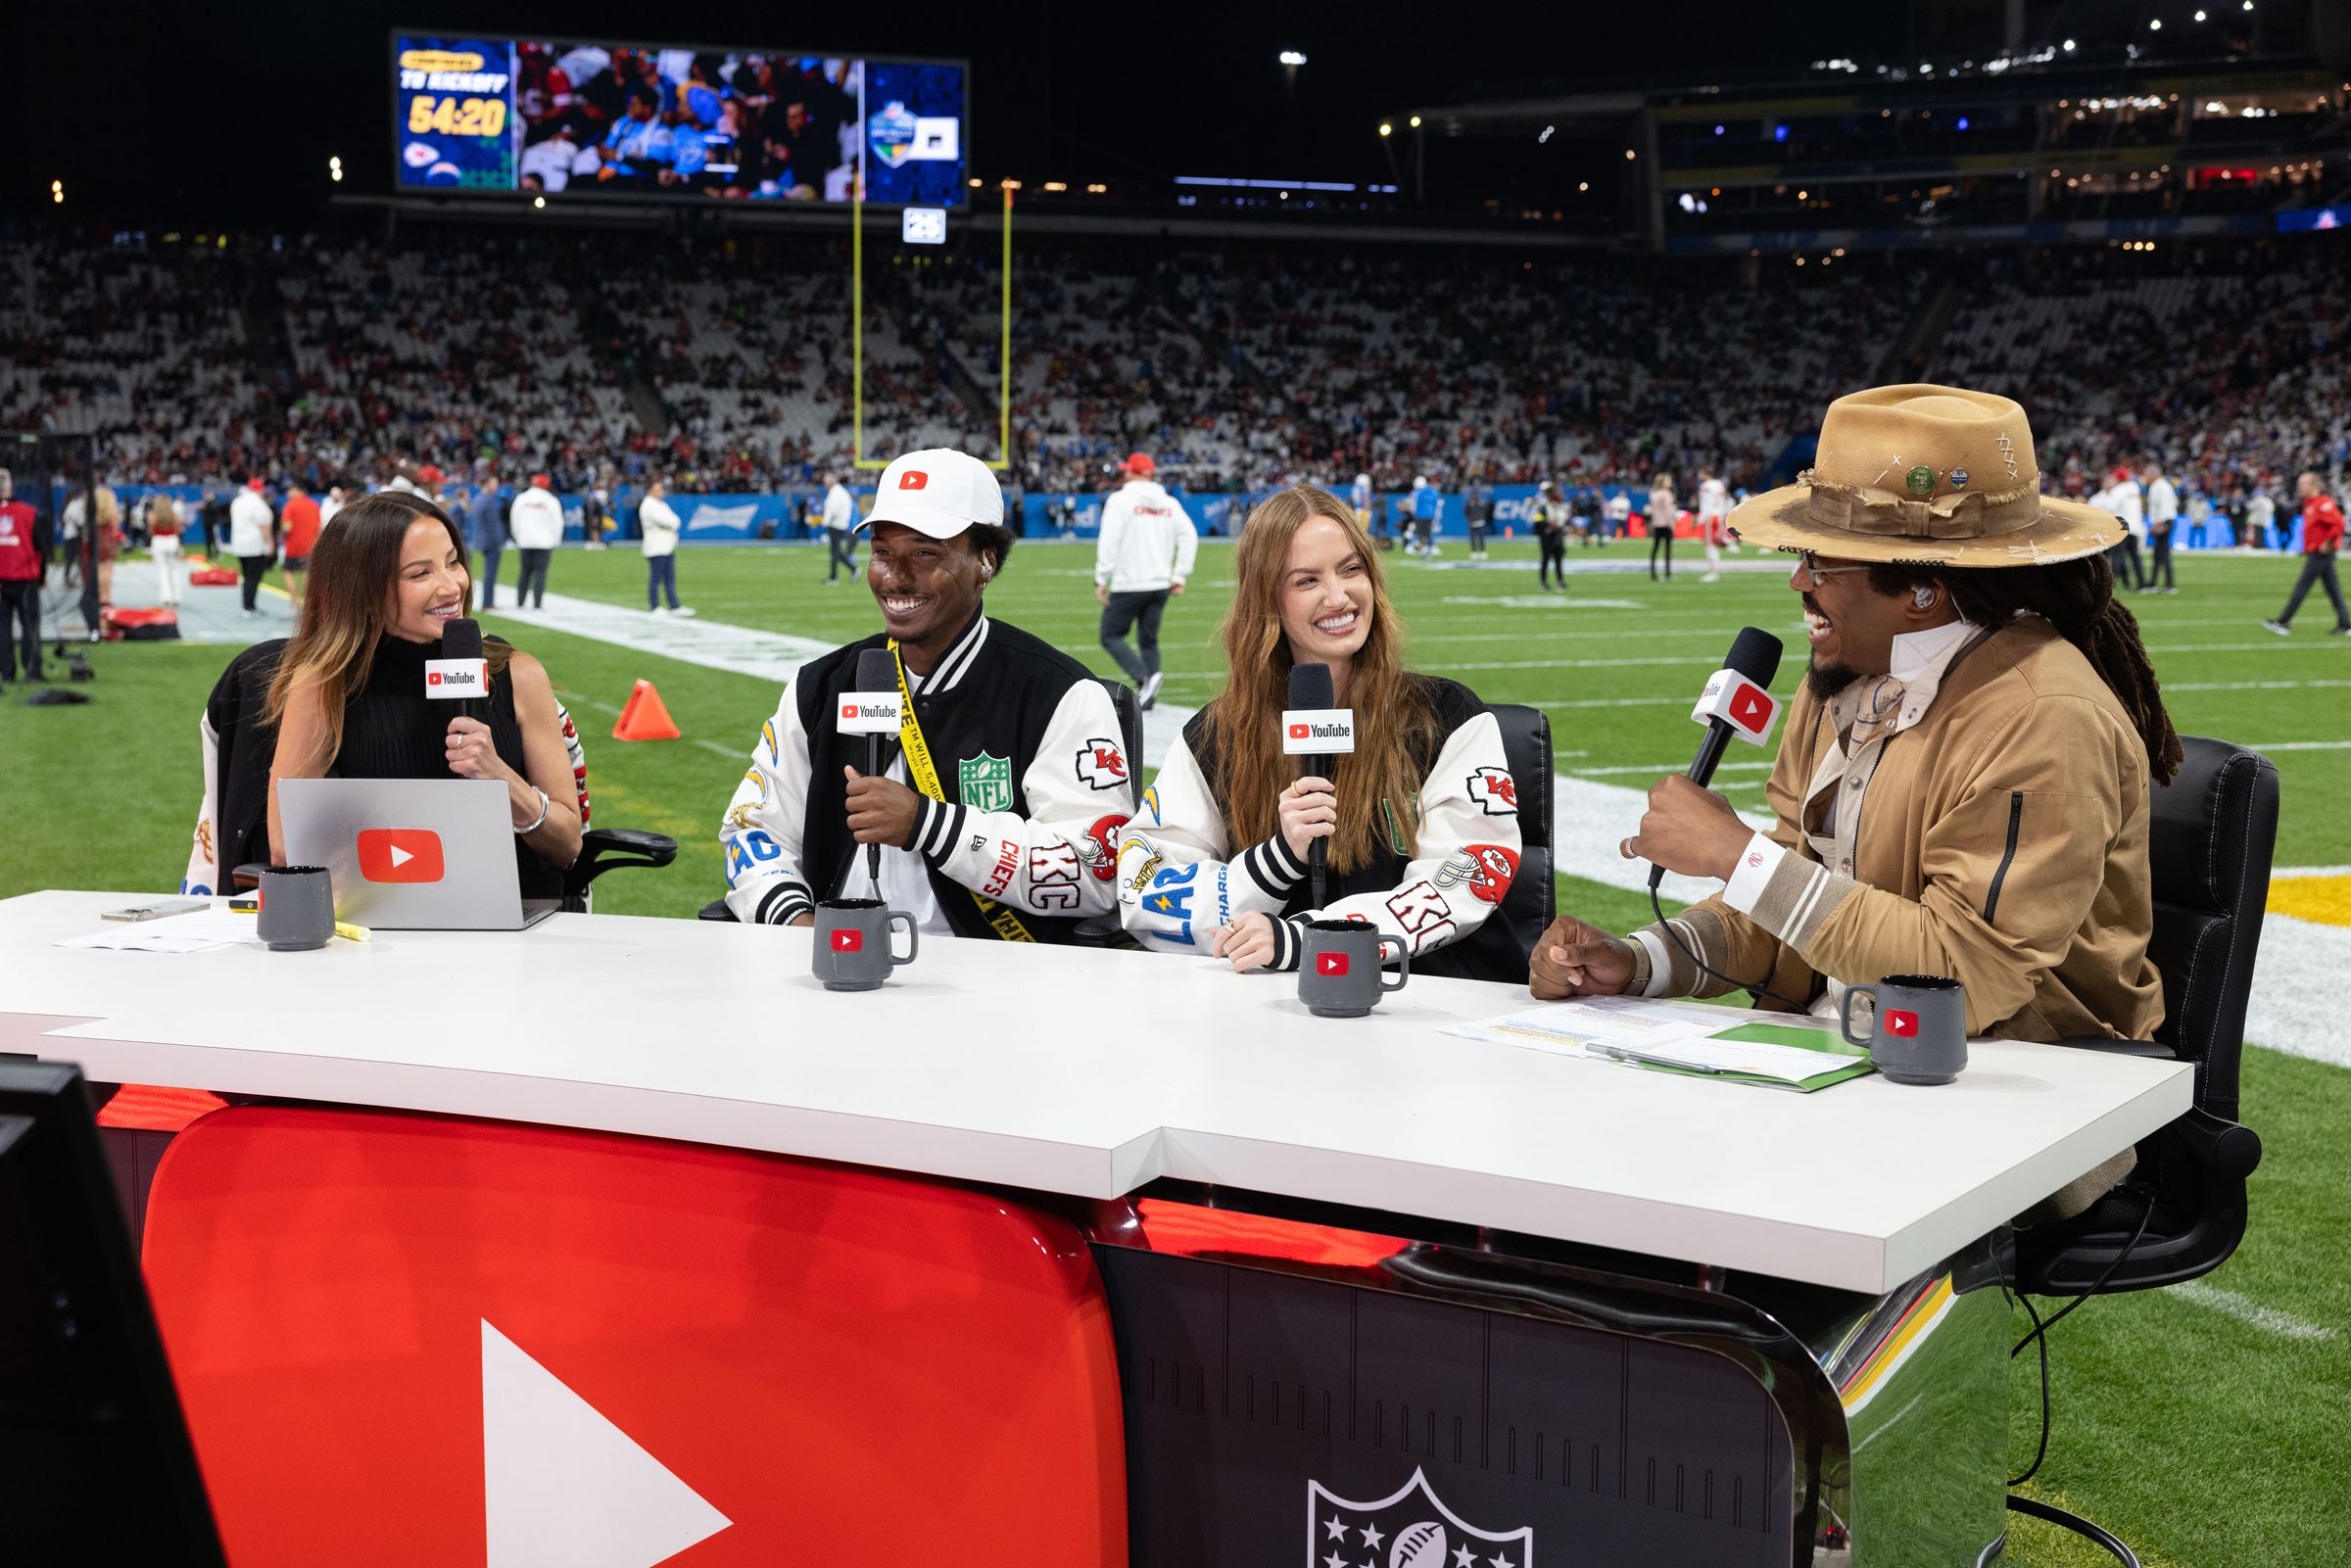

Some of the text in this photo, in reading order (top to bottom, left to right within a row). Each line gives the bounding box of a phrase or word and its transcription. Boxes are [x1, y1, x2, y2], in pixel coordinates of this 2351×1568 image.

[408, 95, 505, 136] 54:20
[443, 672, 475, 685] YouTube
[860, 705, 896, 717] YouTube
[1311, 724, 1350, 737] YouTube
[1093, 748, 1127, 778] KC
[966, 781, 1008, 809] NFL
[1485, 775, 1518, 808] KC
[983, 838, 1020, 898] CHIEFS
[1029, 842, 1081, 910] KC
